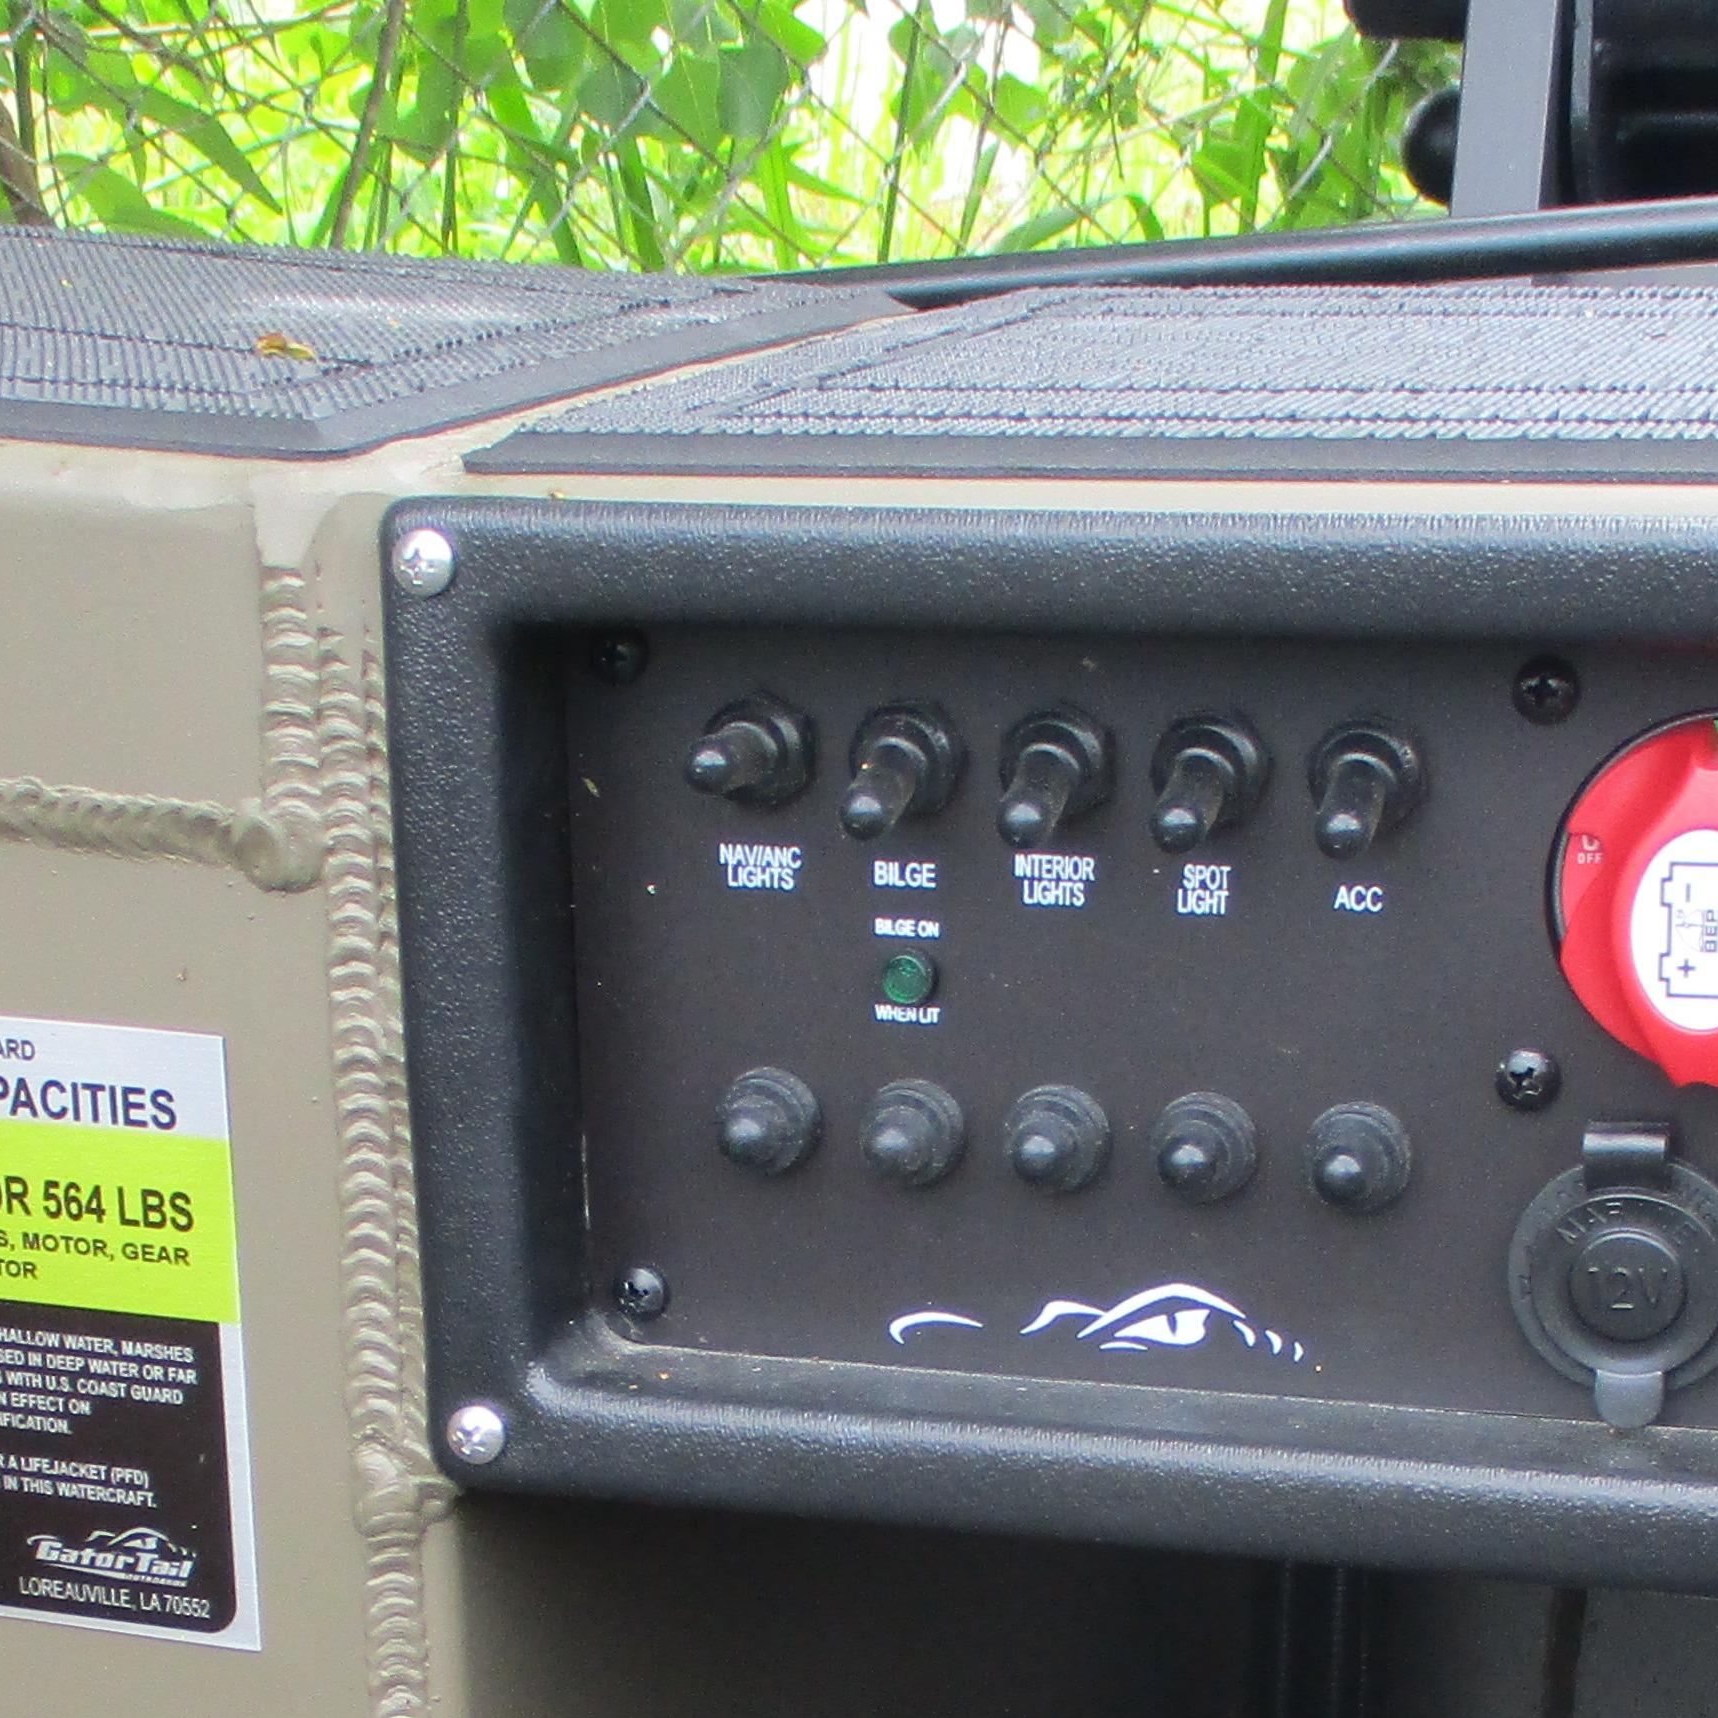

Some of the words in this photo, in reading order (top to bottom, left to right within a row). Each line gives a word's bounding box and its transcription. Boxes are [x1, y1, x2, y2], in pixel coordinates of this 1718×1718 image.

[718, 842, 802, 869] NAV/ANC
[1013, 853, 1096, 882] INTERIOR
[1577, 852, 1603, 865] OFF
[727, 865, 795, 891] LIGHTS
[873, 860, 937, 889] BILGE
[1182, 863, 1231, 890] SPOT
[1022, 880, 1085, 907] LIGHTS
[1176, 889, 1230, 915] LIGHT
[1333, 885, 1383, 913] ACC
[874, 917, 916, 937] BILGE
[917, 920, 940, 938] ON
[1704, 909, 1718, 953] BEP
[874, 1003, 918, 1022] WHEN
[919, 1006, 941, 1024] LIT
[42, 1179, 106, 1224] 564
[117, 1185, 195, 1233] LBS
[21, 1231, 114, 1261] MOTOR,
[121, 1242, 191, 1267] GEAR
[62, 1334, 118, 1357] WATER,
[121, 1340, 195, 1363] MARSHES
[27, 1352, 43, 1367] IN
[46, 1353, 84, 1372] DEEP
[87, 1357, 139, 1378] WATER
[142, 1364, 165, 1382] OR
[168, 1367, 198, 1386] FAR
[5, 1370, 43, 1388] WITH
[45, 1375, 73, 1393] U.S.
[77, 1378, 127, 1398] COAST
[130, 1384, 184, 1405] GUARD
[10, 1391, 65, 1413] EFFECT
[68, 1398, 92, 1416] ON
[7, 1455, 19, 1470] A
[19, 1456, 108, 1481] LIFEJACKET
[110, 1466, 149, 1489] (PFD)
[3, 1474, 19, 1491] IN
[21, 1477, 54, 1495] THIS
[56, 1481, 157, 1508] WATERCRAFT.
[35, 1541, 194, 1578] GatorTail
[19, 1576, 137, 1611] LOREAUVILLE,
[140, 1591, 162, 1612] LA
[163, 1594, 211, 1620] 70552
